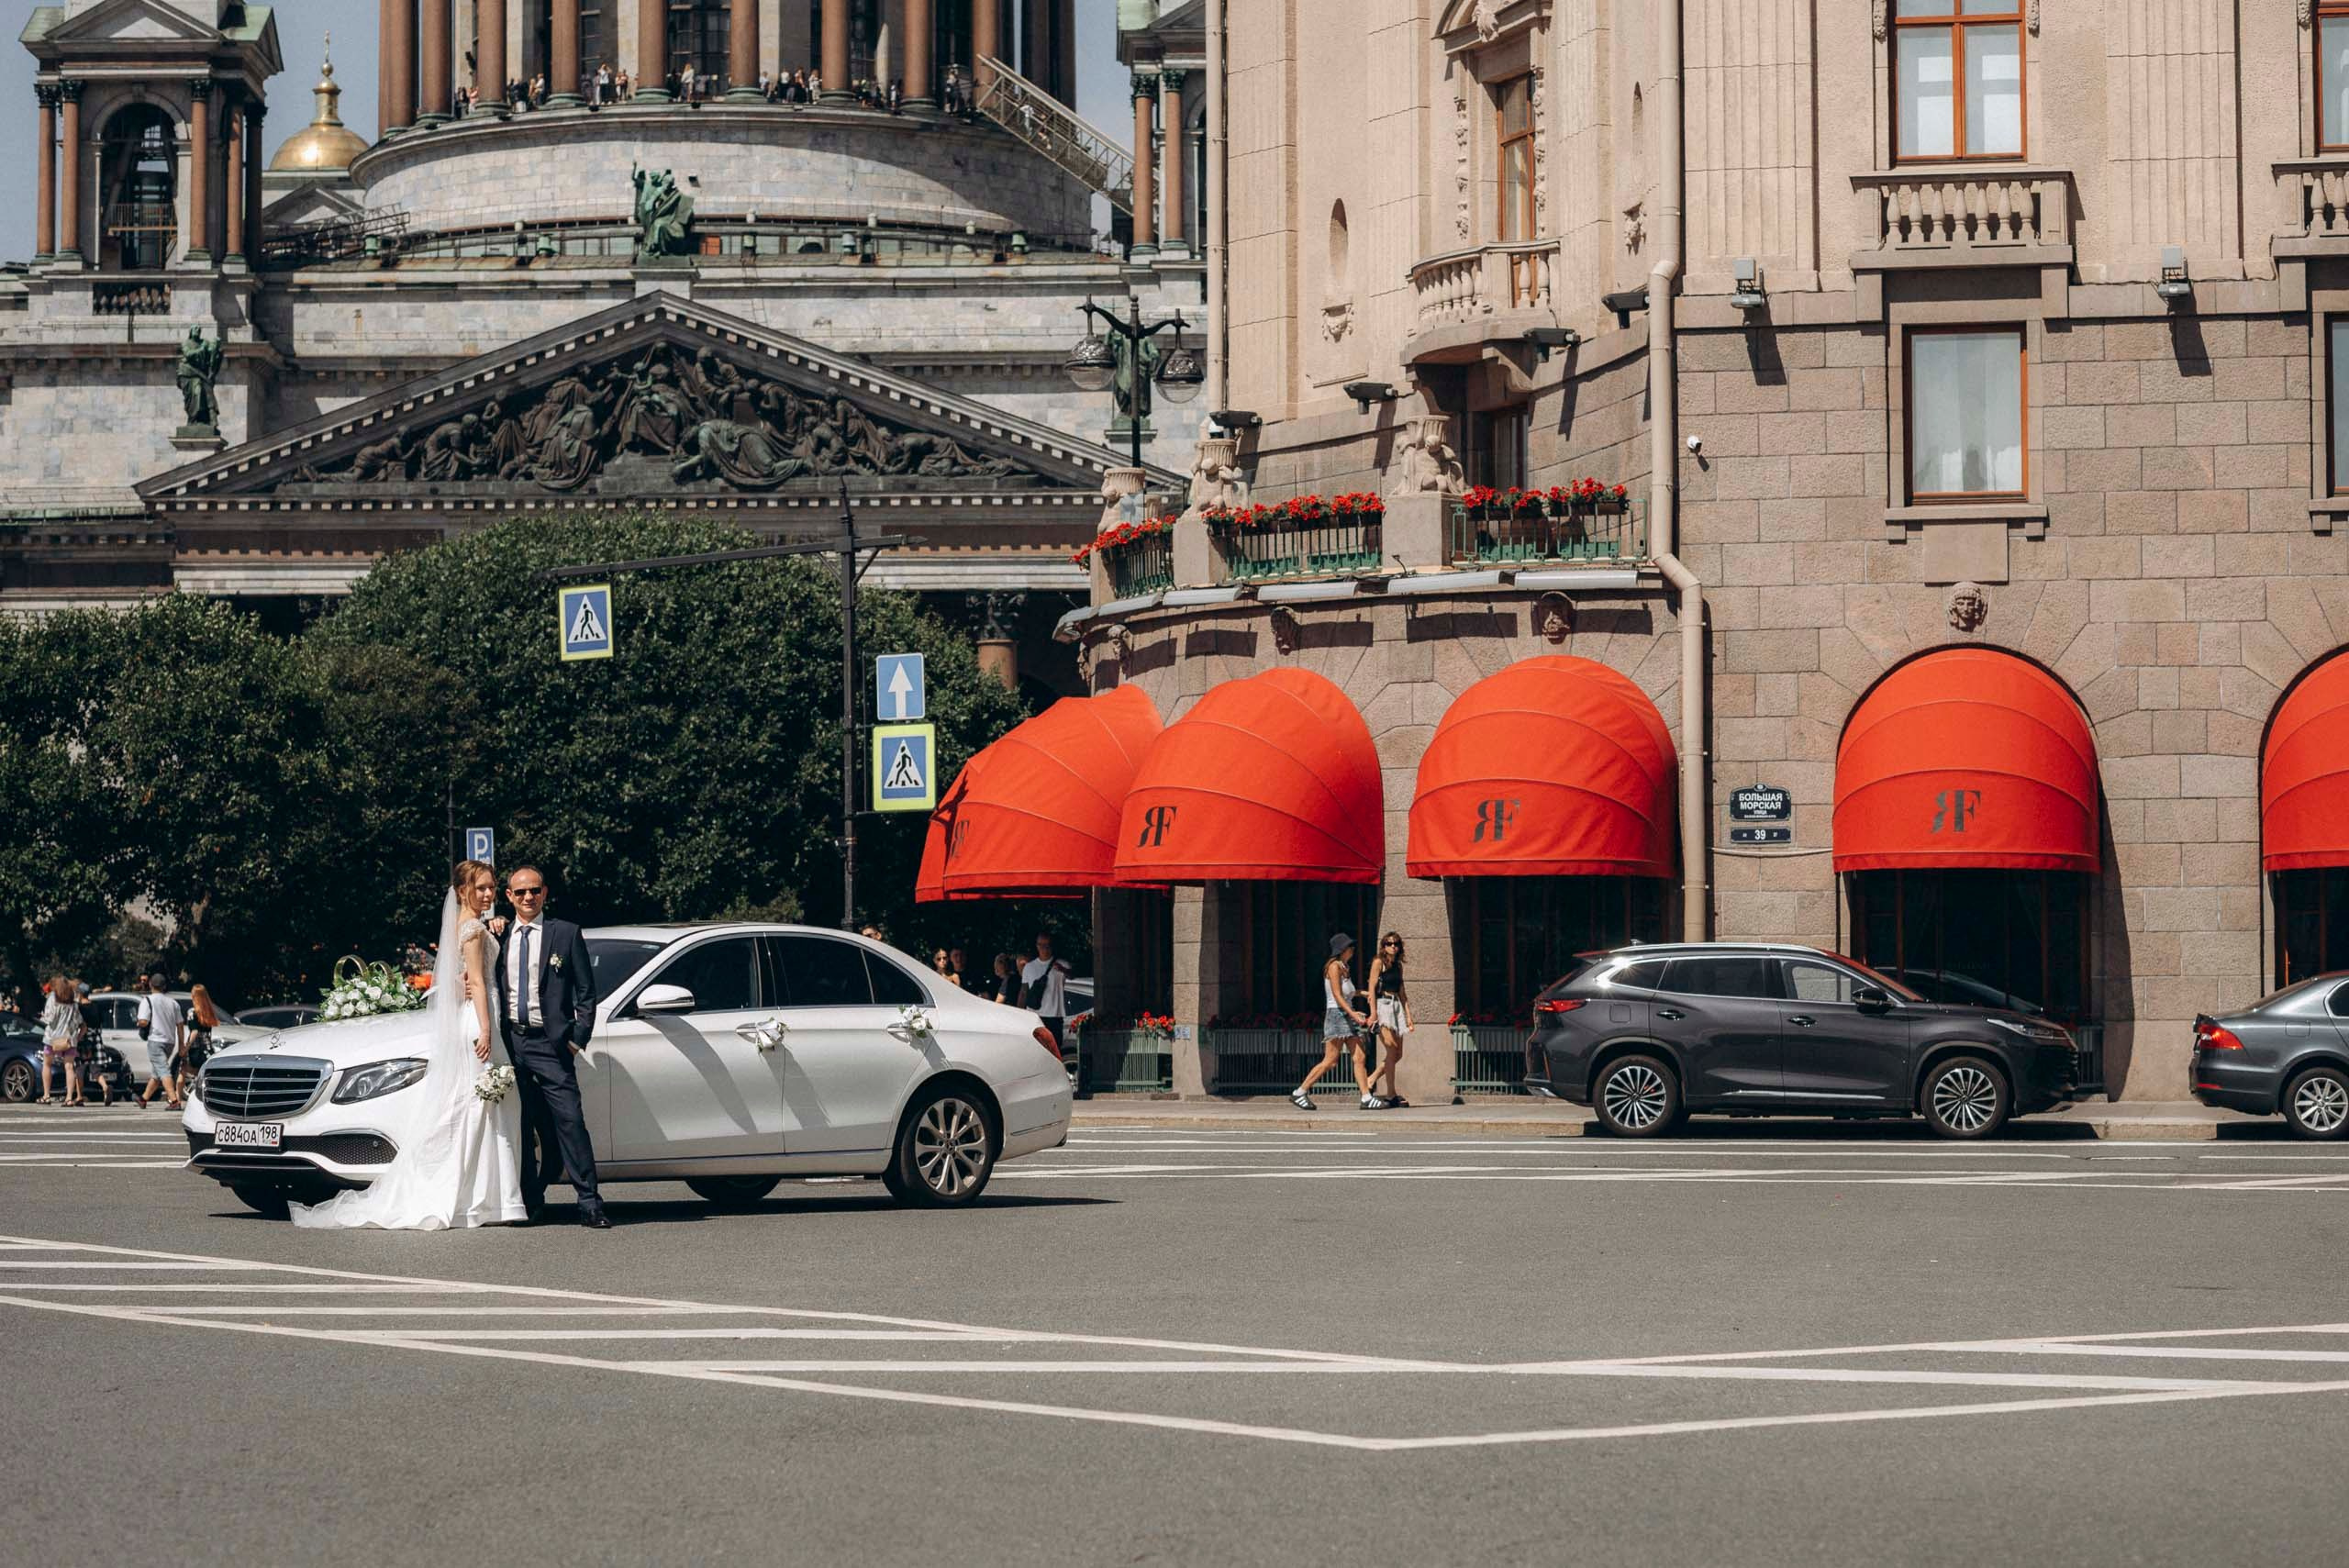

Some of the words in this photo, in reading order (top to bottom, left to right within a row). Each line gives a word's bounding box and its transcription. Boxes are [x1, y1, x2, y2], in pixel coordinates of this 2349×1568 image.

[1739, 793, 1783, 802] БОЛЬШАЯ
[1740, 801, 1782, 810] МОРСКАЯ
[1754, 829, 1766, 840] 39
[474, 833, 488, 861] P
[260, 1126, 277, 1140] 198
